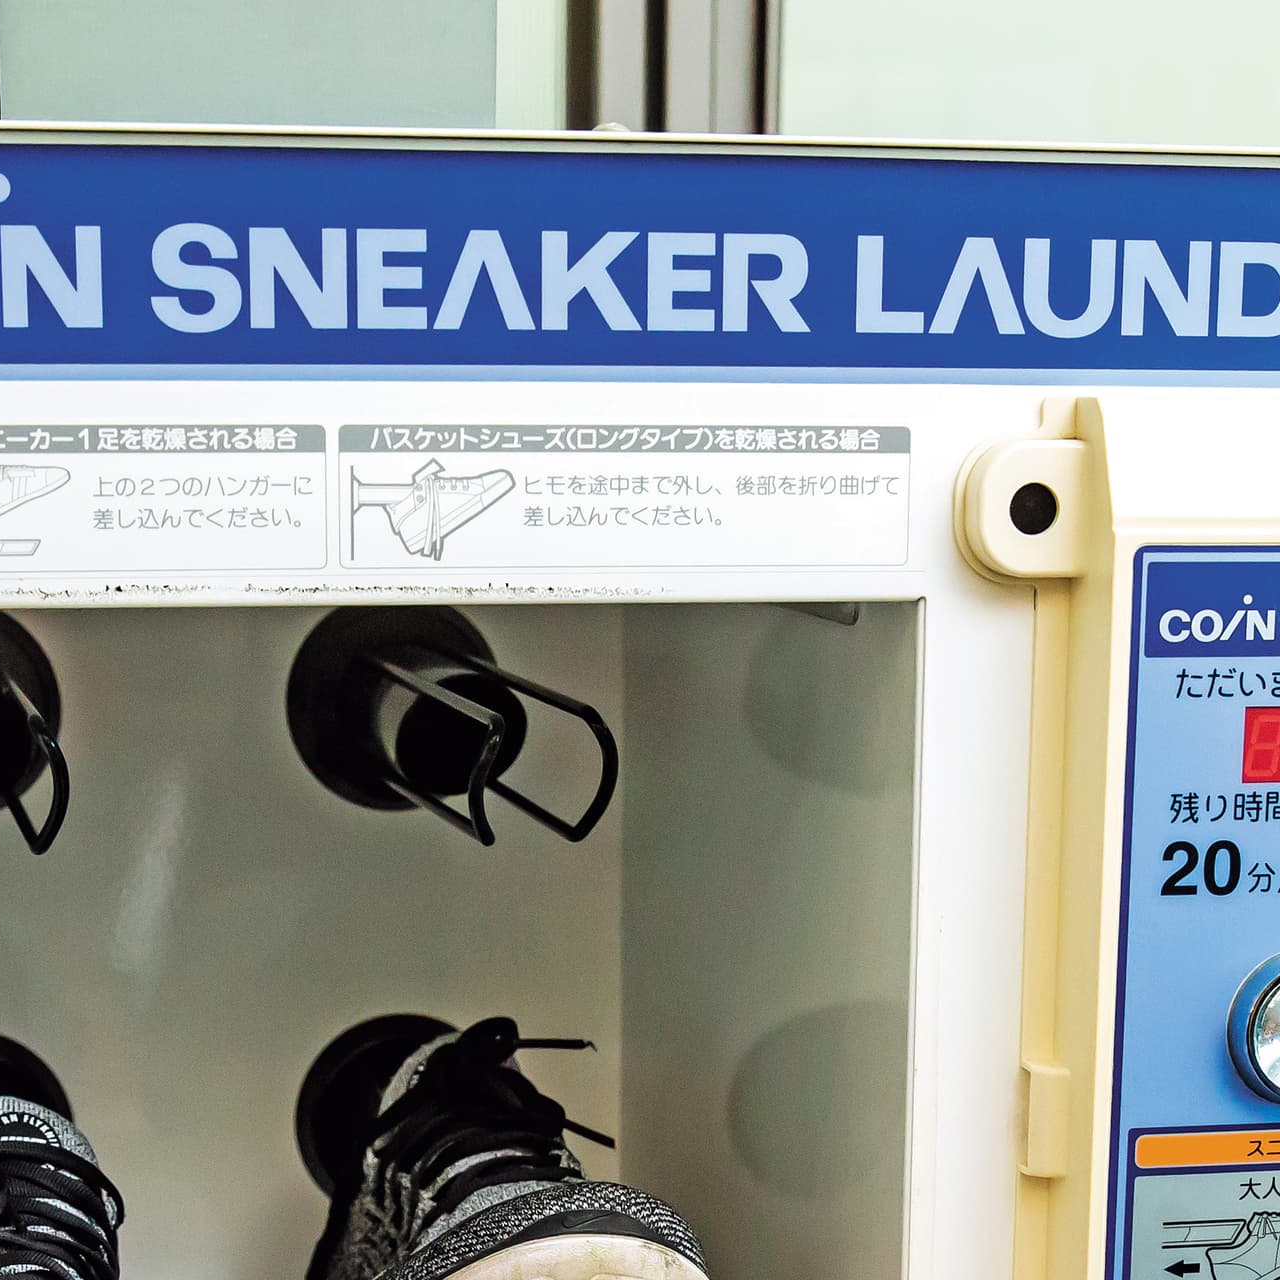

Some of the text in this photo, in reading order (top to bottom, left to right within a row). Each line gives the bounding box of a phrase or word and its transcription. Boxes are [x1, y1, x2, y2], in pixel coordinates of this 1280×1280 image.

[151, 222, 811, 336] SNEAKER
[370, 427, 881, 451] バスケットシューズ(ロングタイプ)を乾燥される場合
[93, 476, 313, 498] 上の2つのハンガーに
[93, 508, 302, 531] 差し込んでください。
[523, 505, 723, 527] 差し込んでください。
[1159, 594, 1276, 642] COIN
